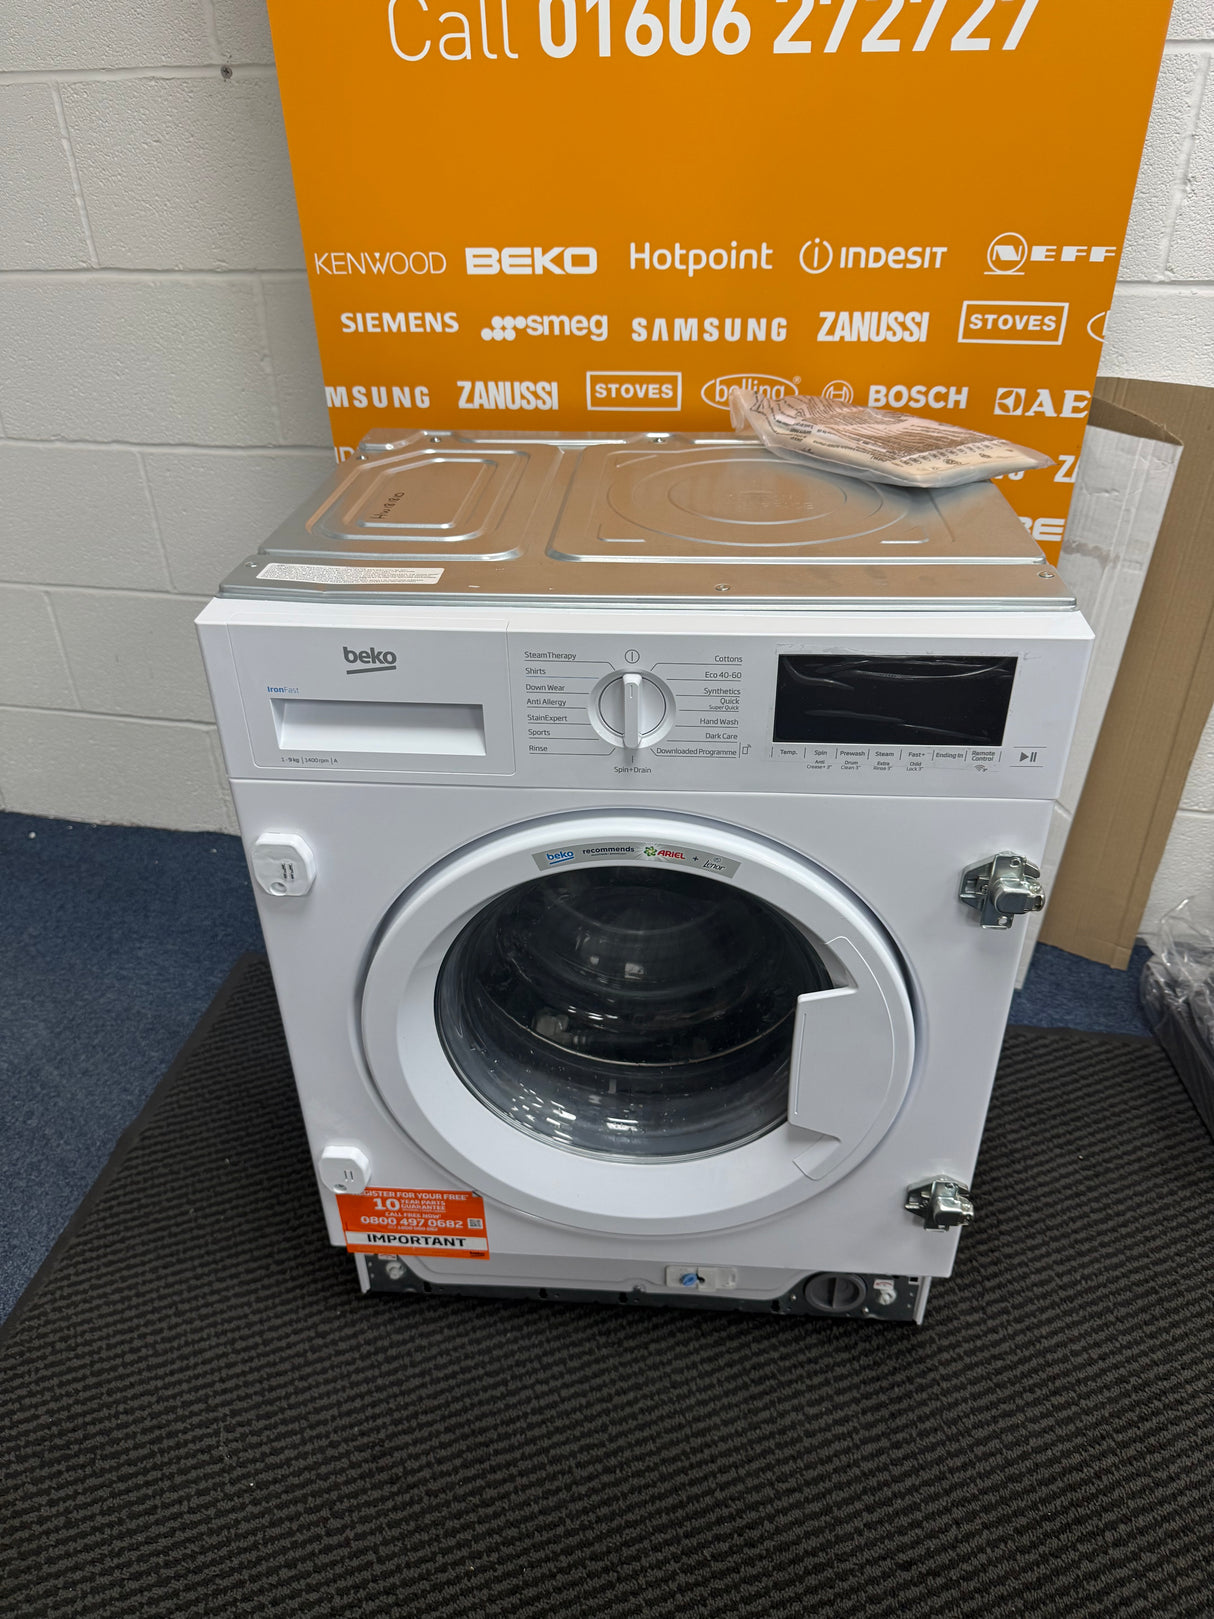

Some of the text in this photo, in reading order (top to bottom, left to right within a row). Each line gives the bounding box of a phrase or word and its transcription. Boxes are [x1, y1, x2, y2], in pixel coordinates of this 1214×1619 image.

[388, 0, 1040, 61] Call 01606 272727
[314, 251, 447, 275] KENWOOD
[465, 247, 598, 275] BEKO
[629, 240, 774, 278] Hotpoint
[340, 312, 459, 334] SIEMENS
[526, 314, 609, 342] smeg
[816, 311, 930, 343] ZANUSSI
[968, 313, 1057, 331] STOVES
[631, 317, 788, 342] SAMSUNG
[456, 380, 559, 411] ZANUSSI
[594, 384, 674, 400] STOVES
[867, 385, 969, 409] BOSCH
[342, 646, 397, 665] beko
[524, 651, 577, 661] SteamTherapy
[714, 655, 743, 663] Cottons
[525, 667, 546, 675] Shirts
[704, 671, 742, 679] Eco 40-60
[267, 686, 300, 694] IronFast
[525, 683, 546, 691] Down
[703, 687, 741, 696] Synthetics
[542, 699, 567, 707] Allergy
[720, 698, 740, 706] Quick
[527, 714, 568, 722] StainExpert
[720, 718, 739, 726] Wash
[528, 729, 551, 738] Sports
[705, 732, 721, 740] Dark
[656, 747, 737, 757] Downloaded Programme
[546, 851, 574, 862] beko
[582, 846, 635, 855] recommends
[657, 849, 686, 860] ARIEL
[373, 1198, 400, 1211] 10
[360, 1216, 397, 1225] 0800
[400, 1218, 425, 1227] 497
[427, 1219, 464, 1229] 0682
[367, 1234, 466, 1247] IMPORTANT
